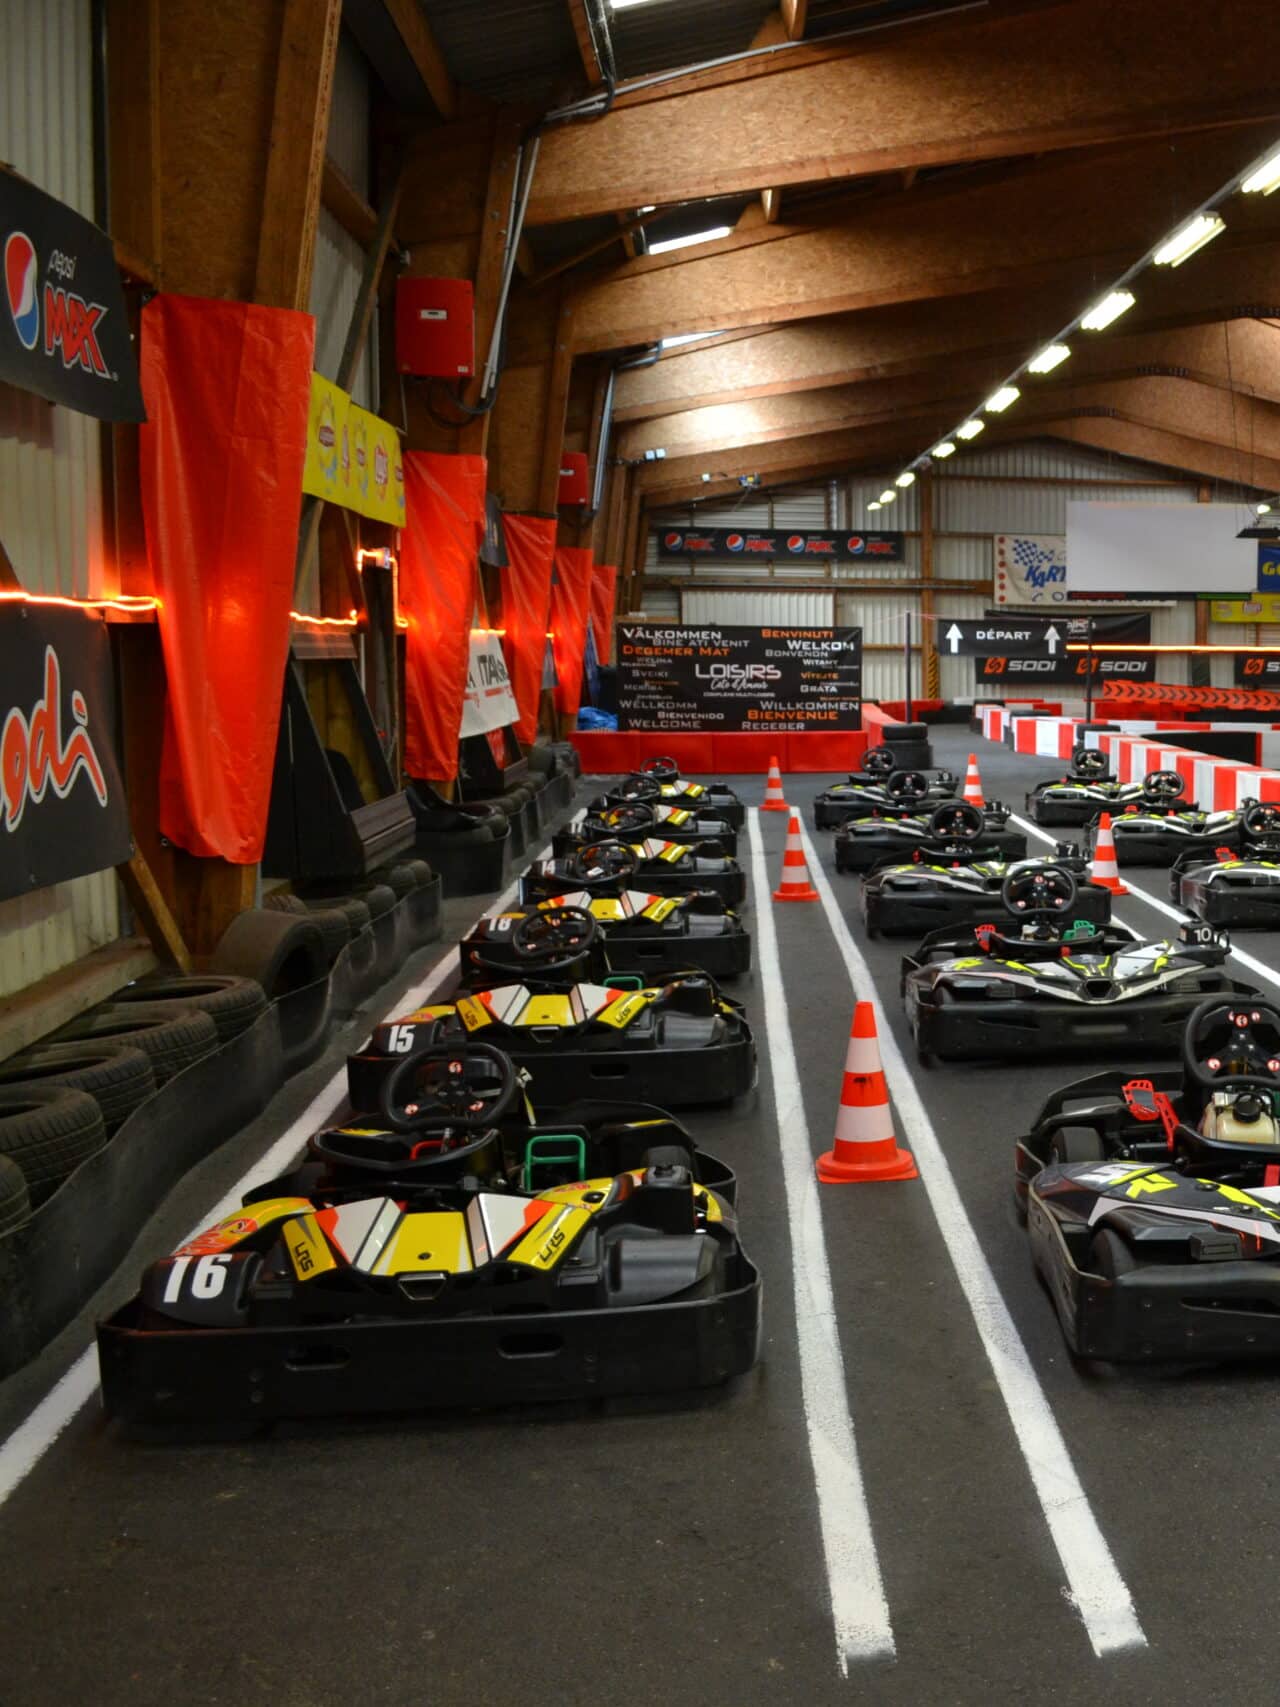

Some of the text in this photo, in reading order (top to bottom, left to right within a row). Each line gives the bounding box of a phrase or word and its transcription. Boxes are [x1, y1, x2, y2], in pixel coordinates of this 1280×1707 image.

[48, 249, 77, 281] pepsi
[44, 280, 112, 379] MAX
[622, 626, 722, 640] VÄLKOMMEN
[761, 628, 834, 639] BENVINUTI
[976, 628, 1032, 641] DÉPART
[712, 640, 750, 648] VENIT
[786, 639, 855, 651] WELKOM
[622, 644, 731, 657] DEGEMER MAT
[695, 663, 782, 679] LOISIRS
[1008, 660, 1057, 672] SODI
[1099, 661, 1148, 673] SODI
[760, 700, 859, 711] WILLKOMMEN
[657, 711, 725, 720] BIENVENIDO
[747, 709, 839, 720] BIENVENUE
[628, 719, 702, 729] WELCOME
[0, 644, 108, 833] odi
[1065, 845, 1074, 855] 7
[1193, 927, 1212, 942] 10
[388, 1024, 417, 1054] 15
[163, 1253, 233, 1303] 16
